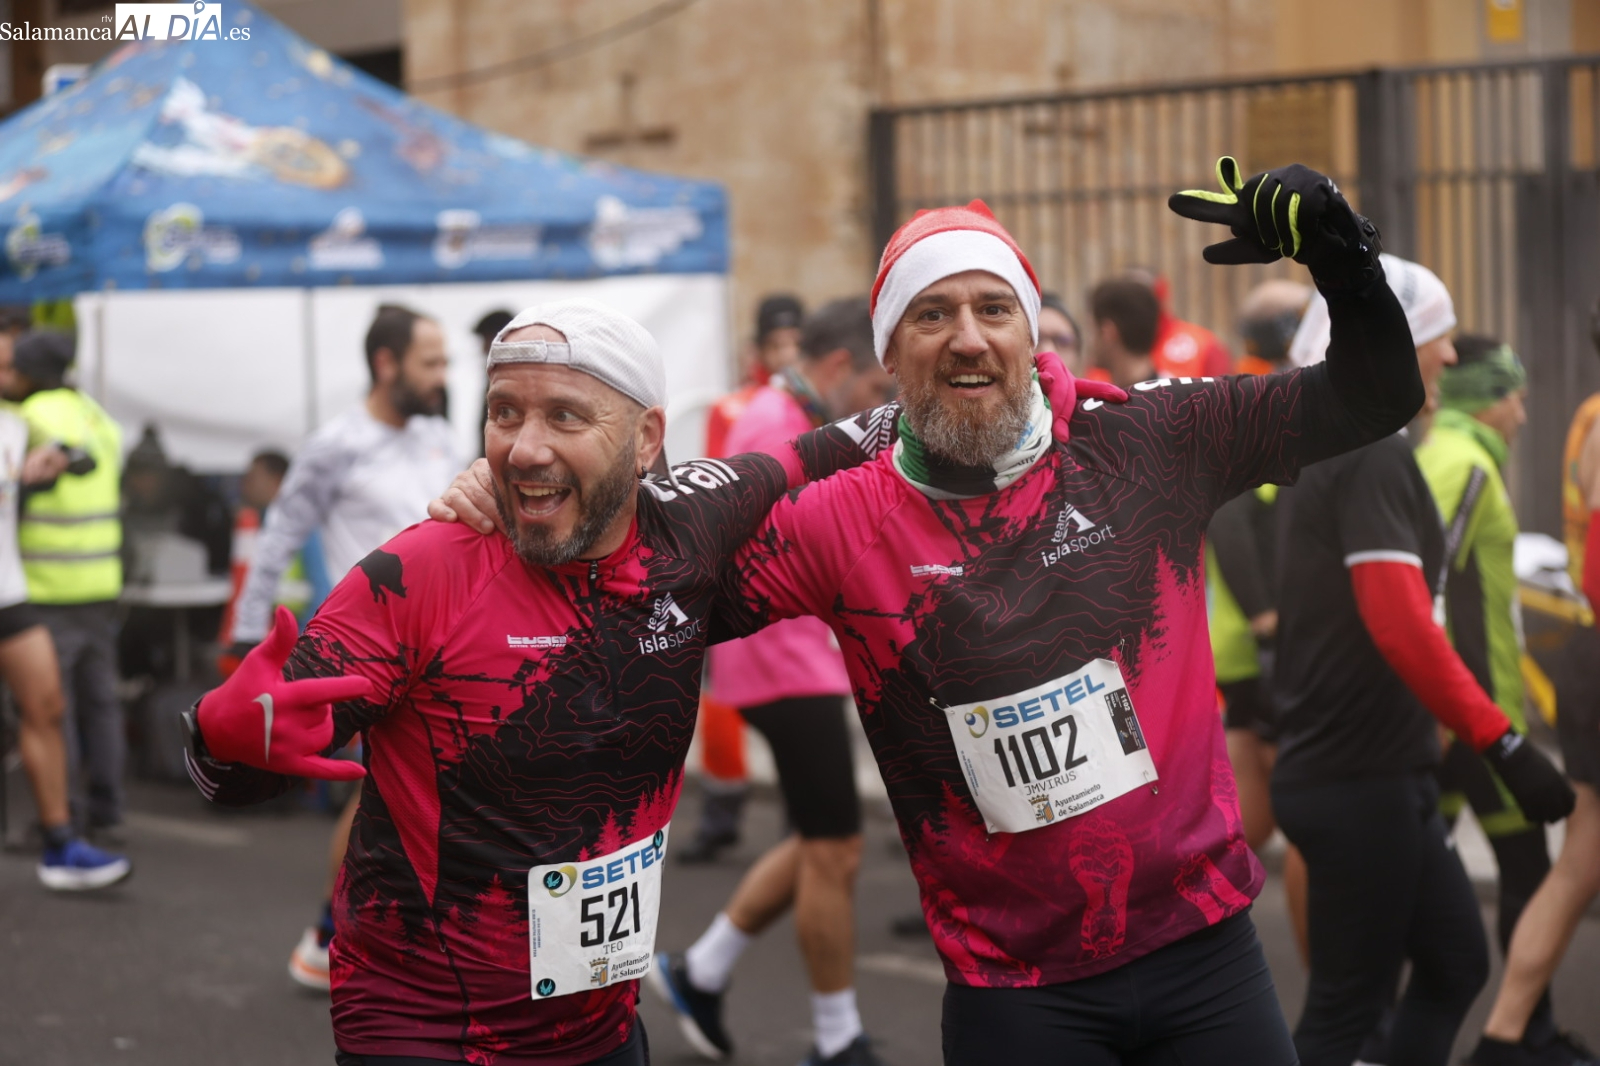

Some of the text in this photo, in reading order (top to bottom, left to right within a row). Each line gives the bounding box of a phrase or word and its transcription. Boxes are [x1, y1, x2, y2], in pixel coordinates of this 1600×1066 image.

[879, 404, 900, 449] team
[1051, 510, 1067, 543] team
[647, 597, 663, 630] team
[992, 674, 1106, 728] SETEL
[1120, 693, 1131, 712] 1102
[994, 714, 1088, 788] 1102
[1024, 770, 1077, 796] JMVIRUS
[1055, 783, 1101, 808] Ayuntamiento
[1058, 793, 1105, 817] de Salamanca
[581, 881, 641, 948] 521
[603, 940, 624, 955] TEO
